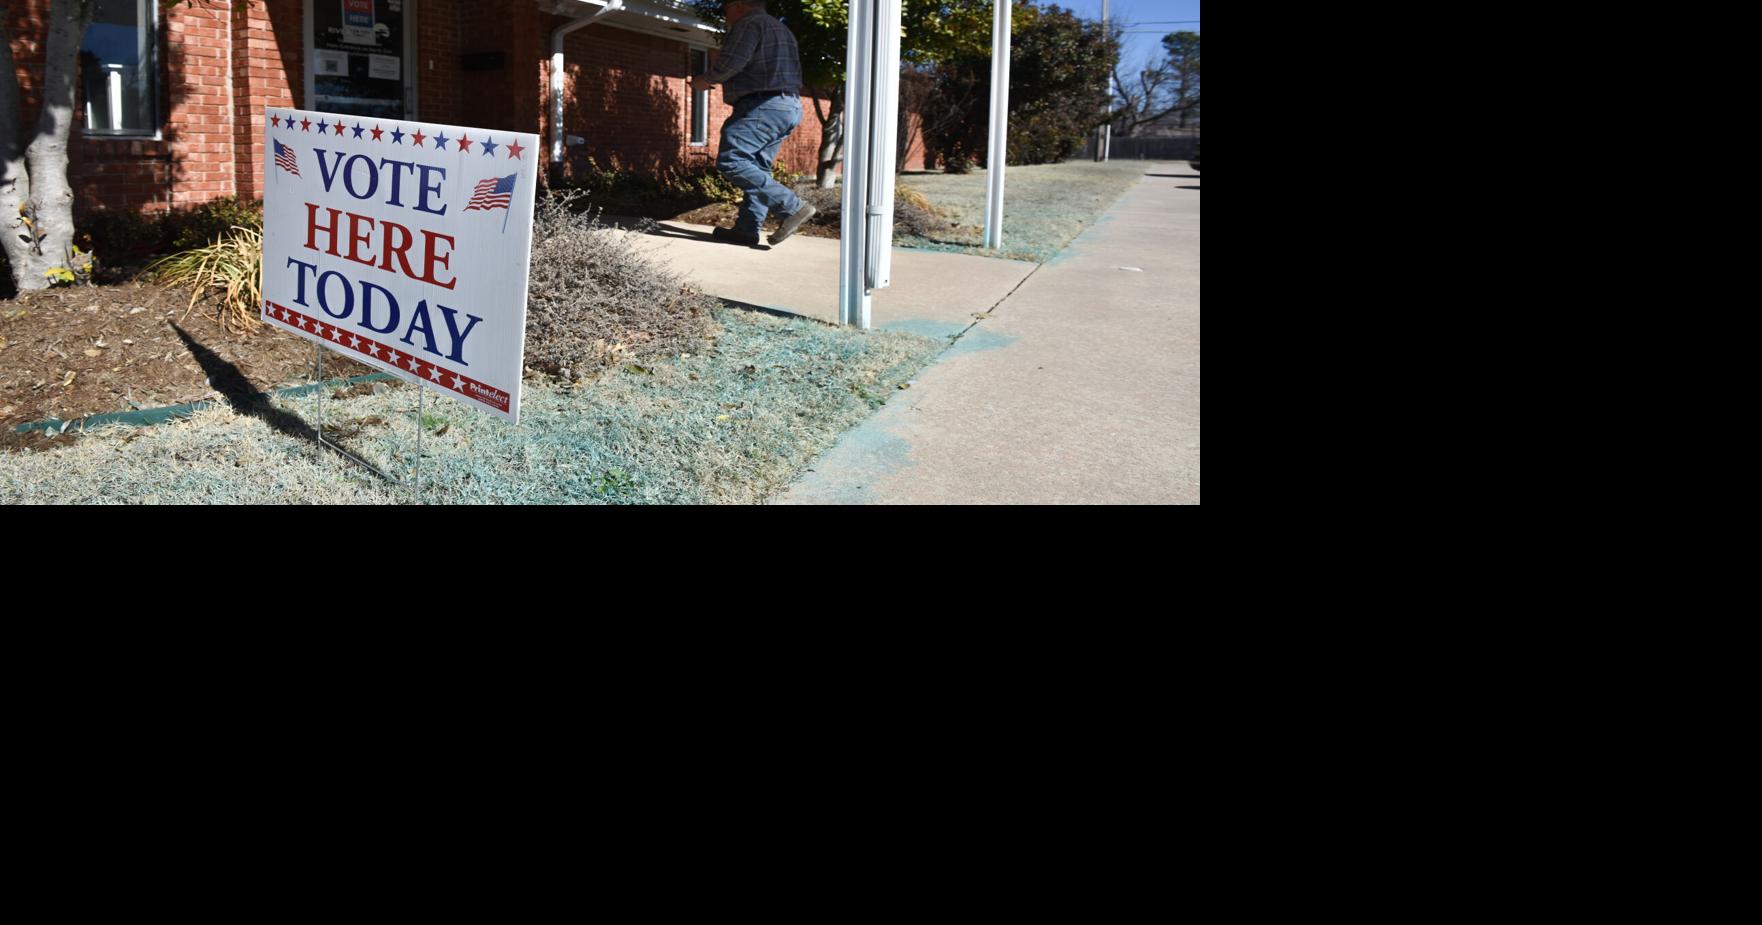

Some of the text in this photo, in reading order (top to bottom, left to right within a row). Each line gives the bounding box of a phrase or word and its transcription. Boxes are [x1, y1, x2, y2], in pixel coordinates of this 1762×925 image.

[348, 0, 369, 9] VOTE
[349, 13, 369, 24] HERE
[313, 148, 448, 216] VOTE
[303, 202, 457, 290] HERE
[286, 256, 483, 366] TODAY
